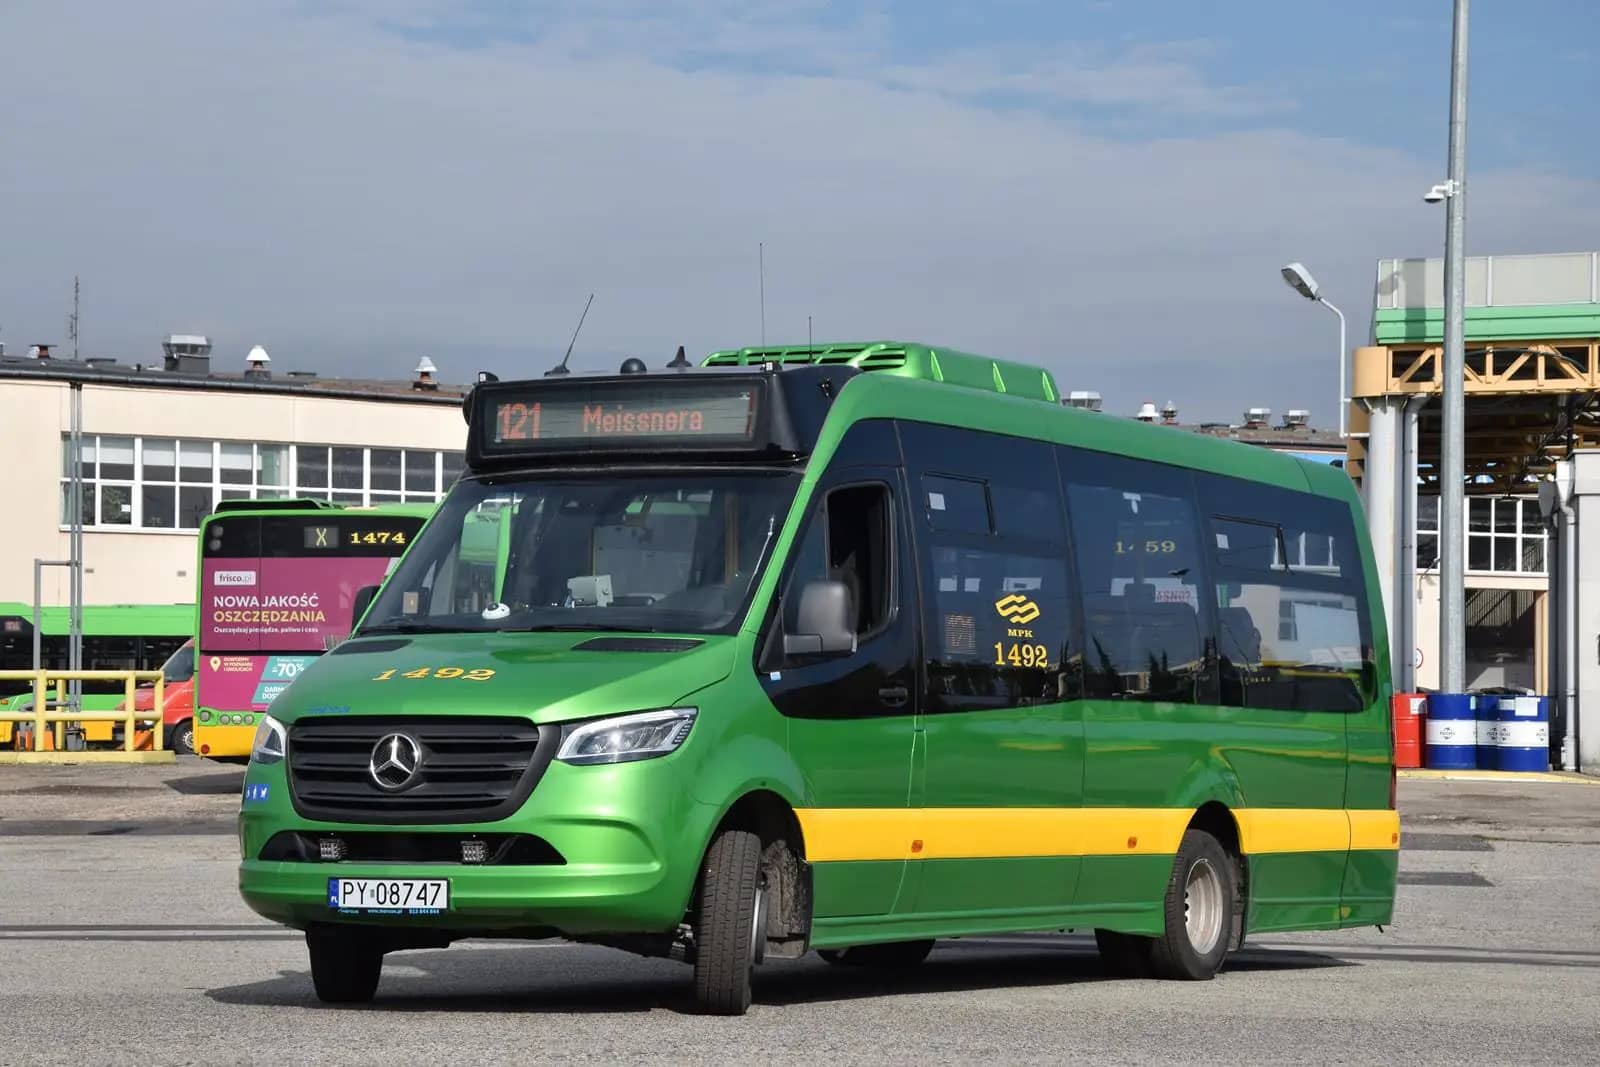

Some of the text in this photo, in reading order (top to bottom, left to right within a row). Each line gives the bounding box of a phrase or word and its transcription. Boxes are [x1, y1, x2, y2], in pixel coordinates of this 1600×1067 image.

[497, 402, 703, 440] 121 Meissnera
[316, 528, 327, 546] X
[350, 532, 405, 544] 1474
[1115, 541, 1176, 553] 159
[214, 593, 319, 607] NOWA JAKOŚĆ
[214, 611, 325, 624] OSZCZĘDZANIA
[1007, 628, 1033, 638] MPK
[993, 642, 1048, 667] 1492
[372, 667, 496, 681] 1492
[343, 882, 441, 905] PY 08747
